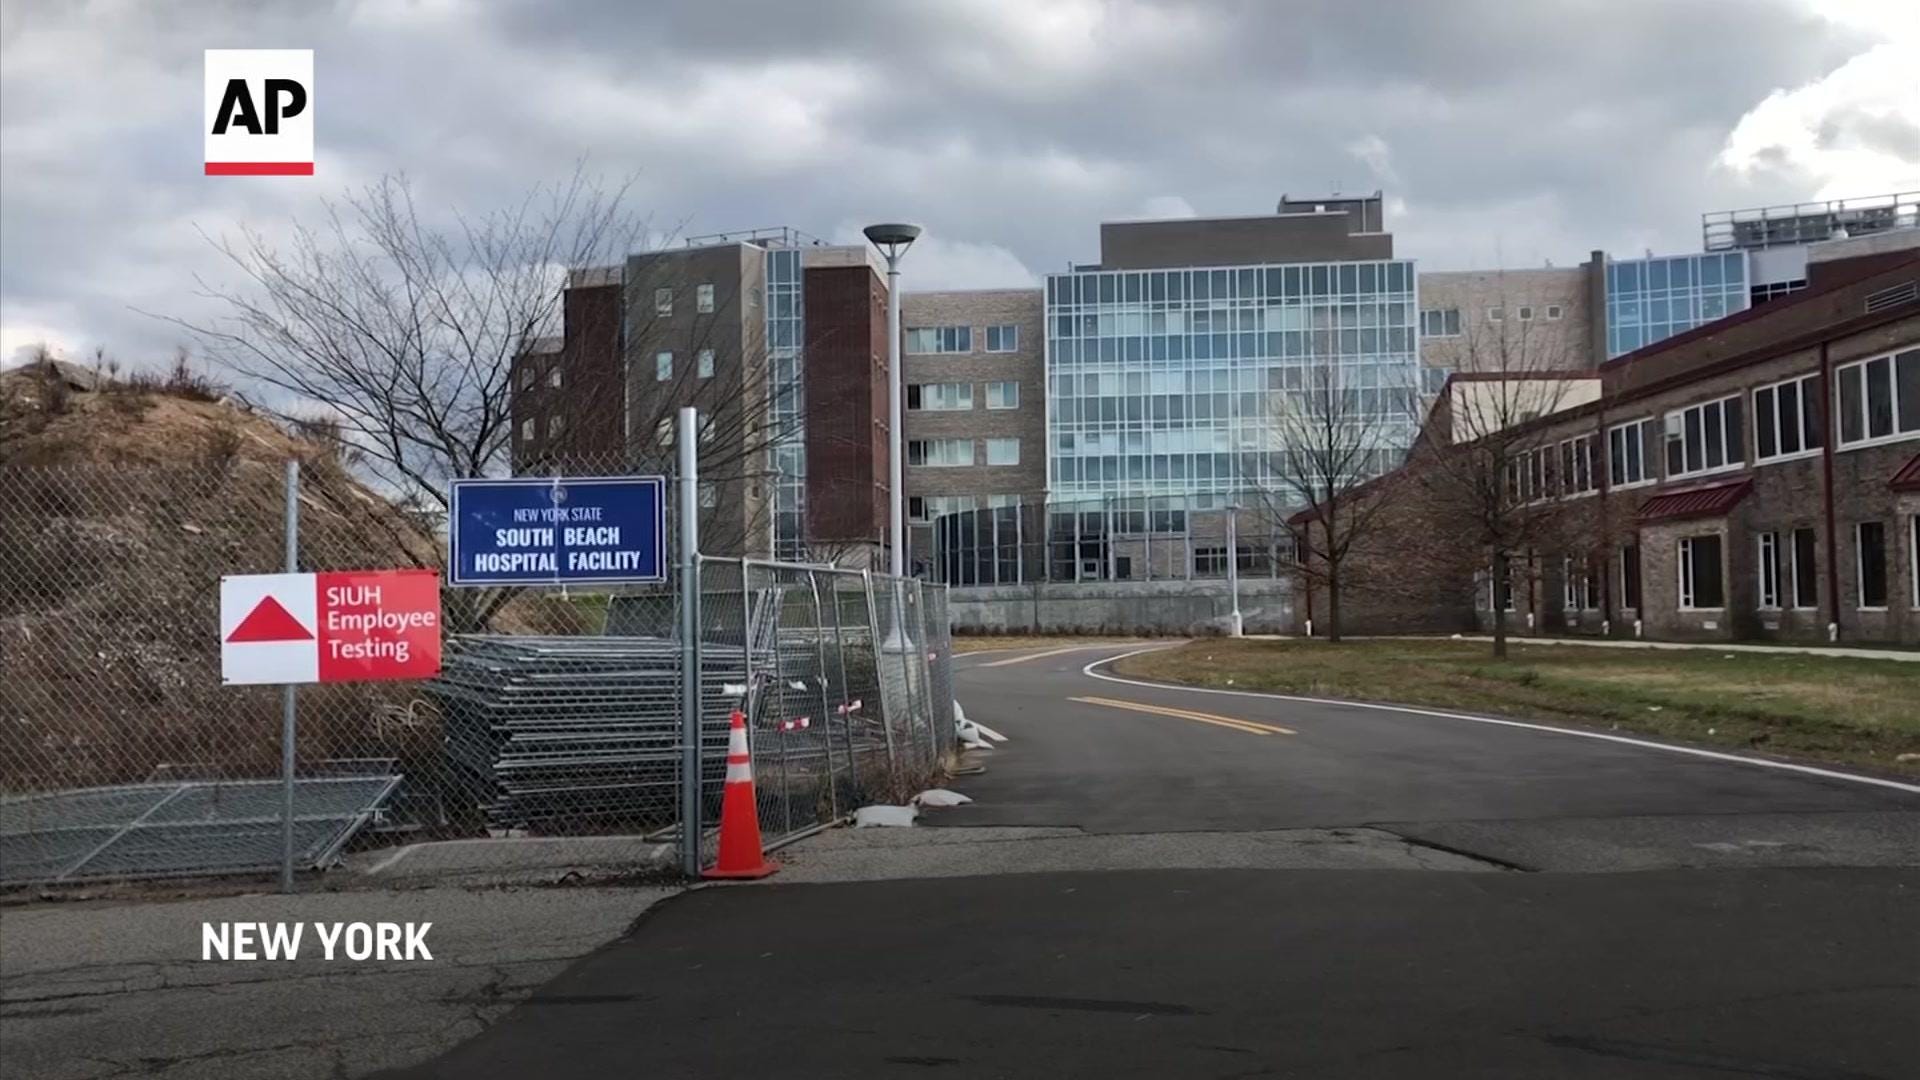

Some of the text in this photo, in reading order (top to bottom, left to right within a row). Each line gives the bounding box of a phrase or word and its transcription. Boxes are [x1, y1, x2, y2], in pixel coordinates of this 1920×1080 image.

[514, 507, 603, 522] NEW YORK STATE
[496, 526, 620, 546] SOUTH BEACH
[475, 551, 641, 572] HOSPITAL FACILITY
[326, 585, 381, 606] SIUH
[328, 608, 435, 635] Employee
[328, 638, 409, 662] Testing
